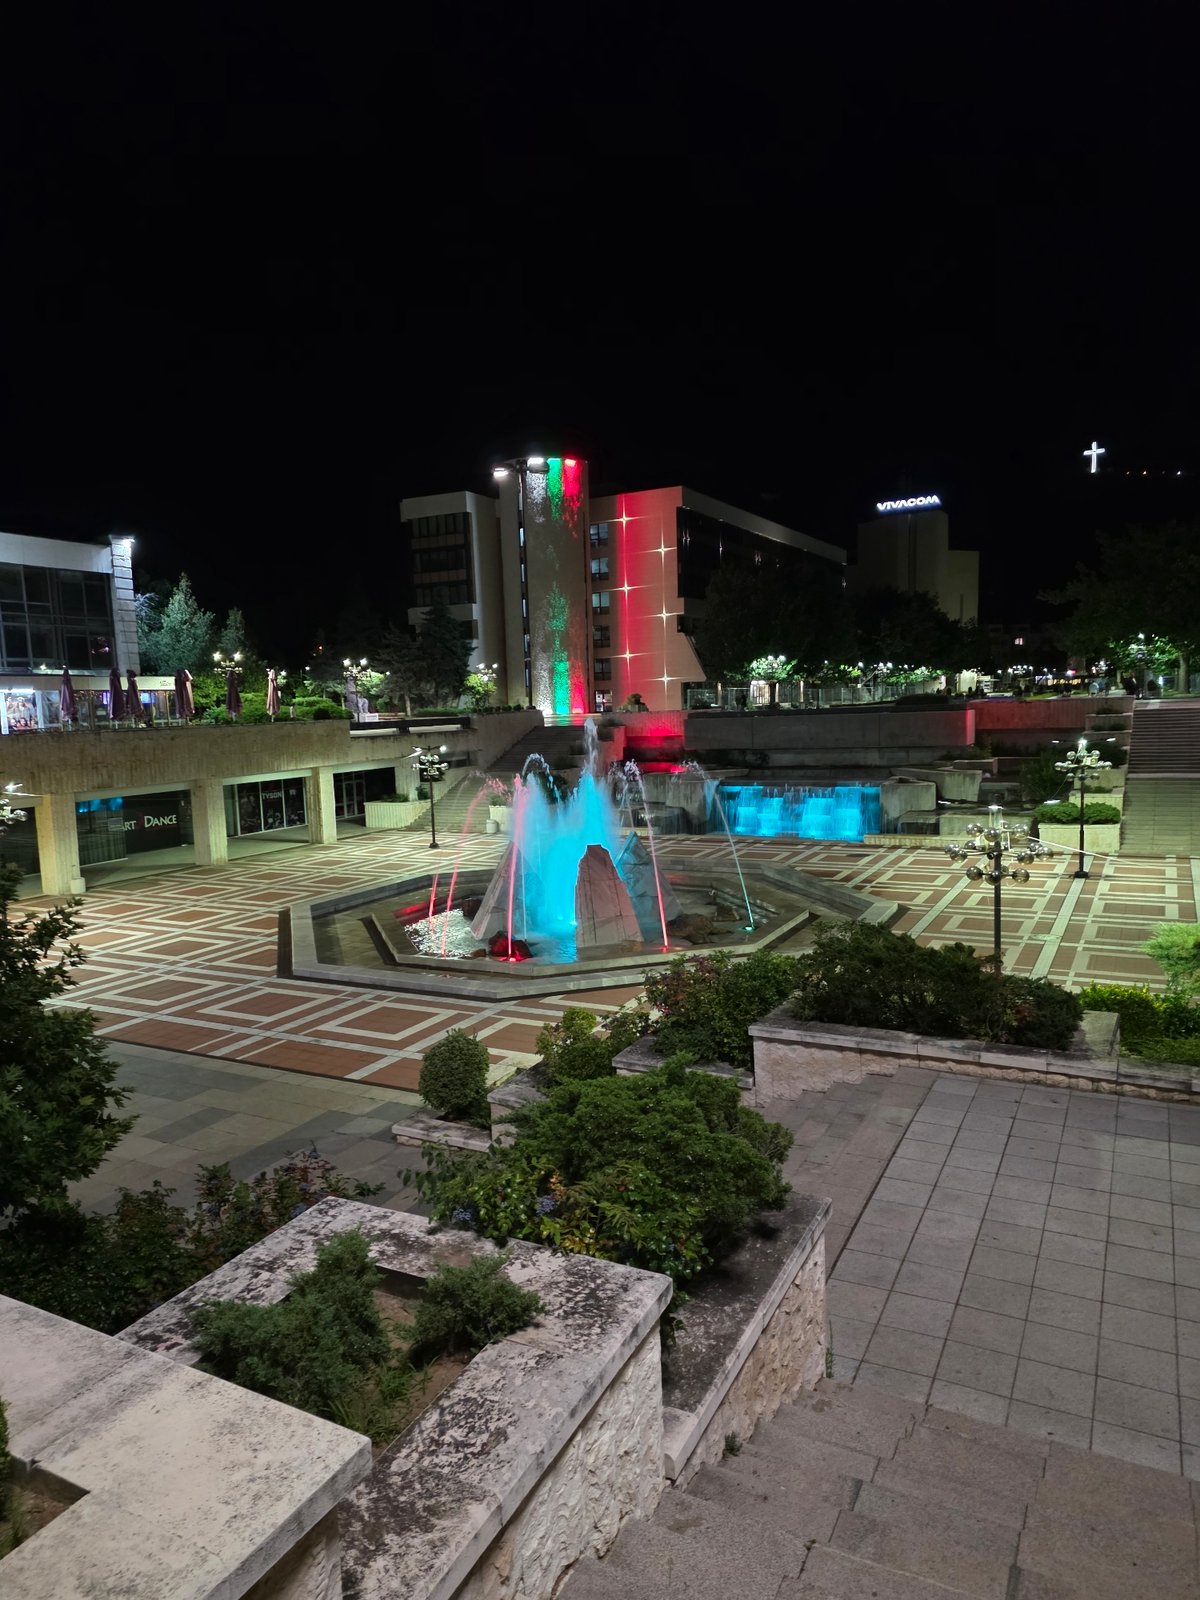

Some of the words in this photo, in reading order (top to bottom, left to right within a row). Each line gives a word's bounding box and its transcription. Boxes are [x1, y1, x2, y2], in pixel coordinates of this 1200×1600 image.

[876, 494, 941, 509] VIVACOM
[261, 791, 282, 800] TYSON
[144, 814, 178, 828] DANCE
